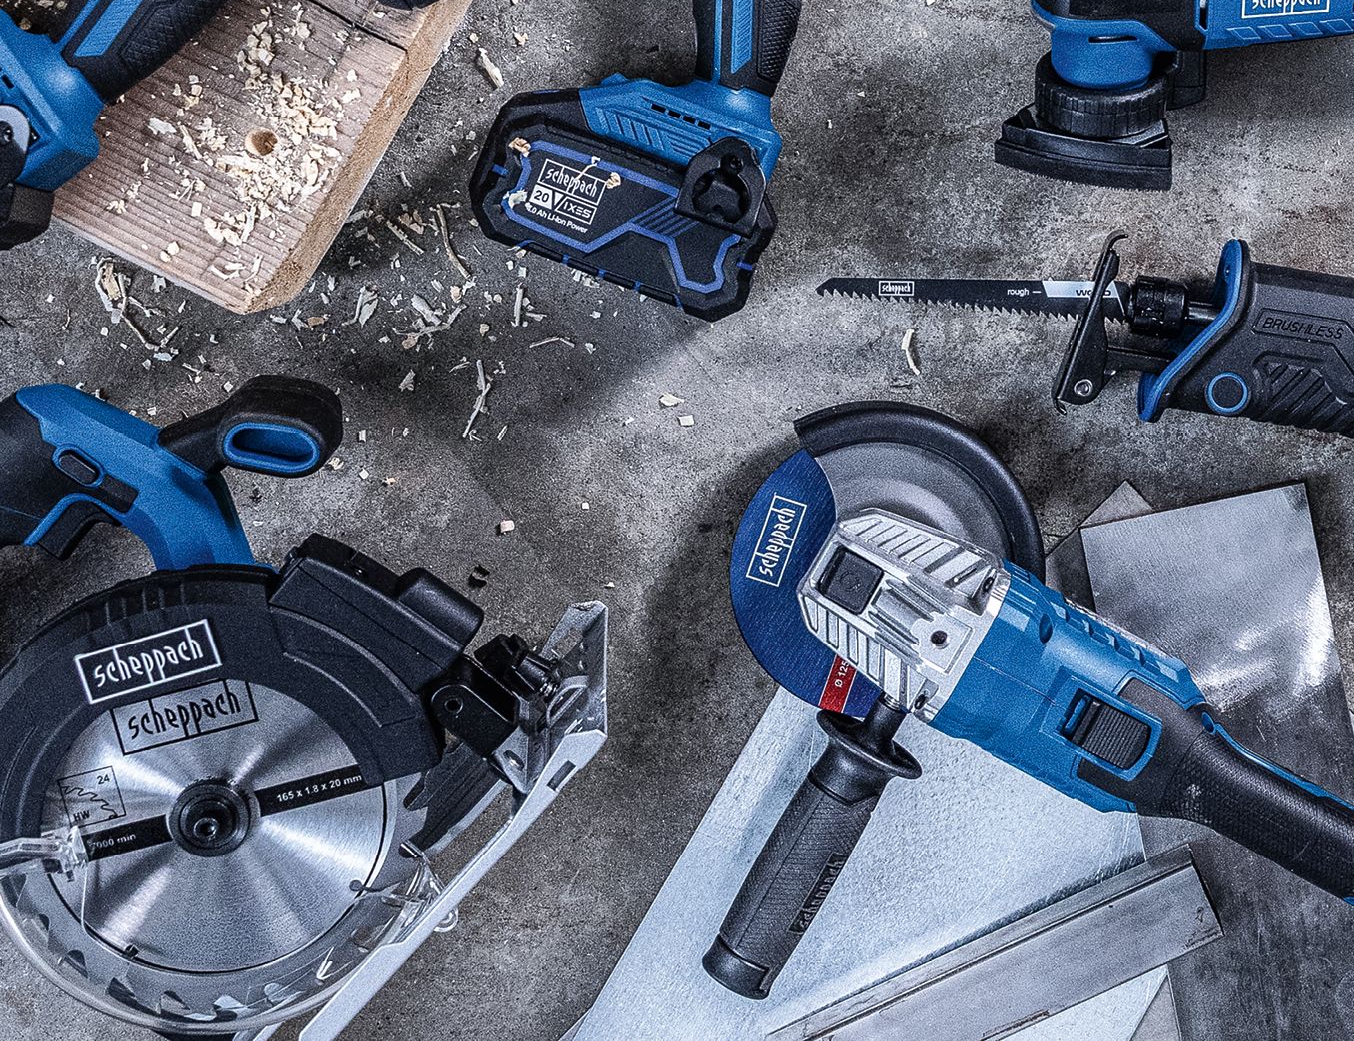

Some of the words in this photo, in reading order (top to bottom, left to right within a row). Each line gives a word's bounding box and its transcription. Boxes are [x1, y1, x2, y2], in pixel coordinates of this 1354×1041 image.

[545, 166, 597, 197] scheppach
[566, 220, 588, 233] Power
[1007, 287, 1030, 297] rough
[1262, 317, 1345, 339] BRUSHLESS
[756, 506, 796, 577] scheppach
[94, 627, 203, 688] scheppach
[838, 661, 849, 677] 125
[128, 680, 241, 740] scheppach
[97, 774, 110, 784] 24
[277, 791, 294, 802] 165
[305, 784, 319, 795] 1.8
[321, 783, 327, 791] x
[329, 779, 341, 788] 20
[343, 775, 362, 785] mm
[73, 810, 90, 822] HW
[116, 834, 136, 843] min
